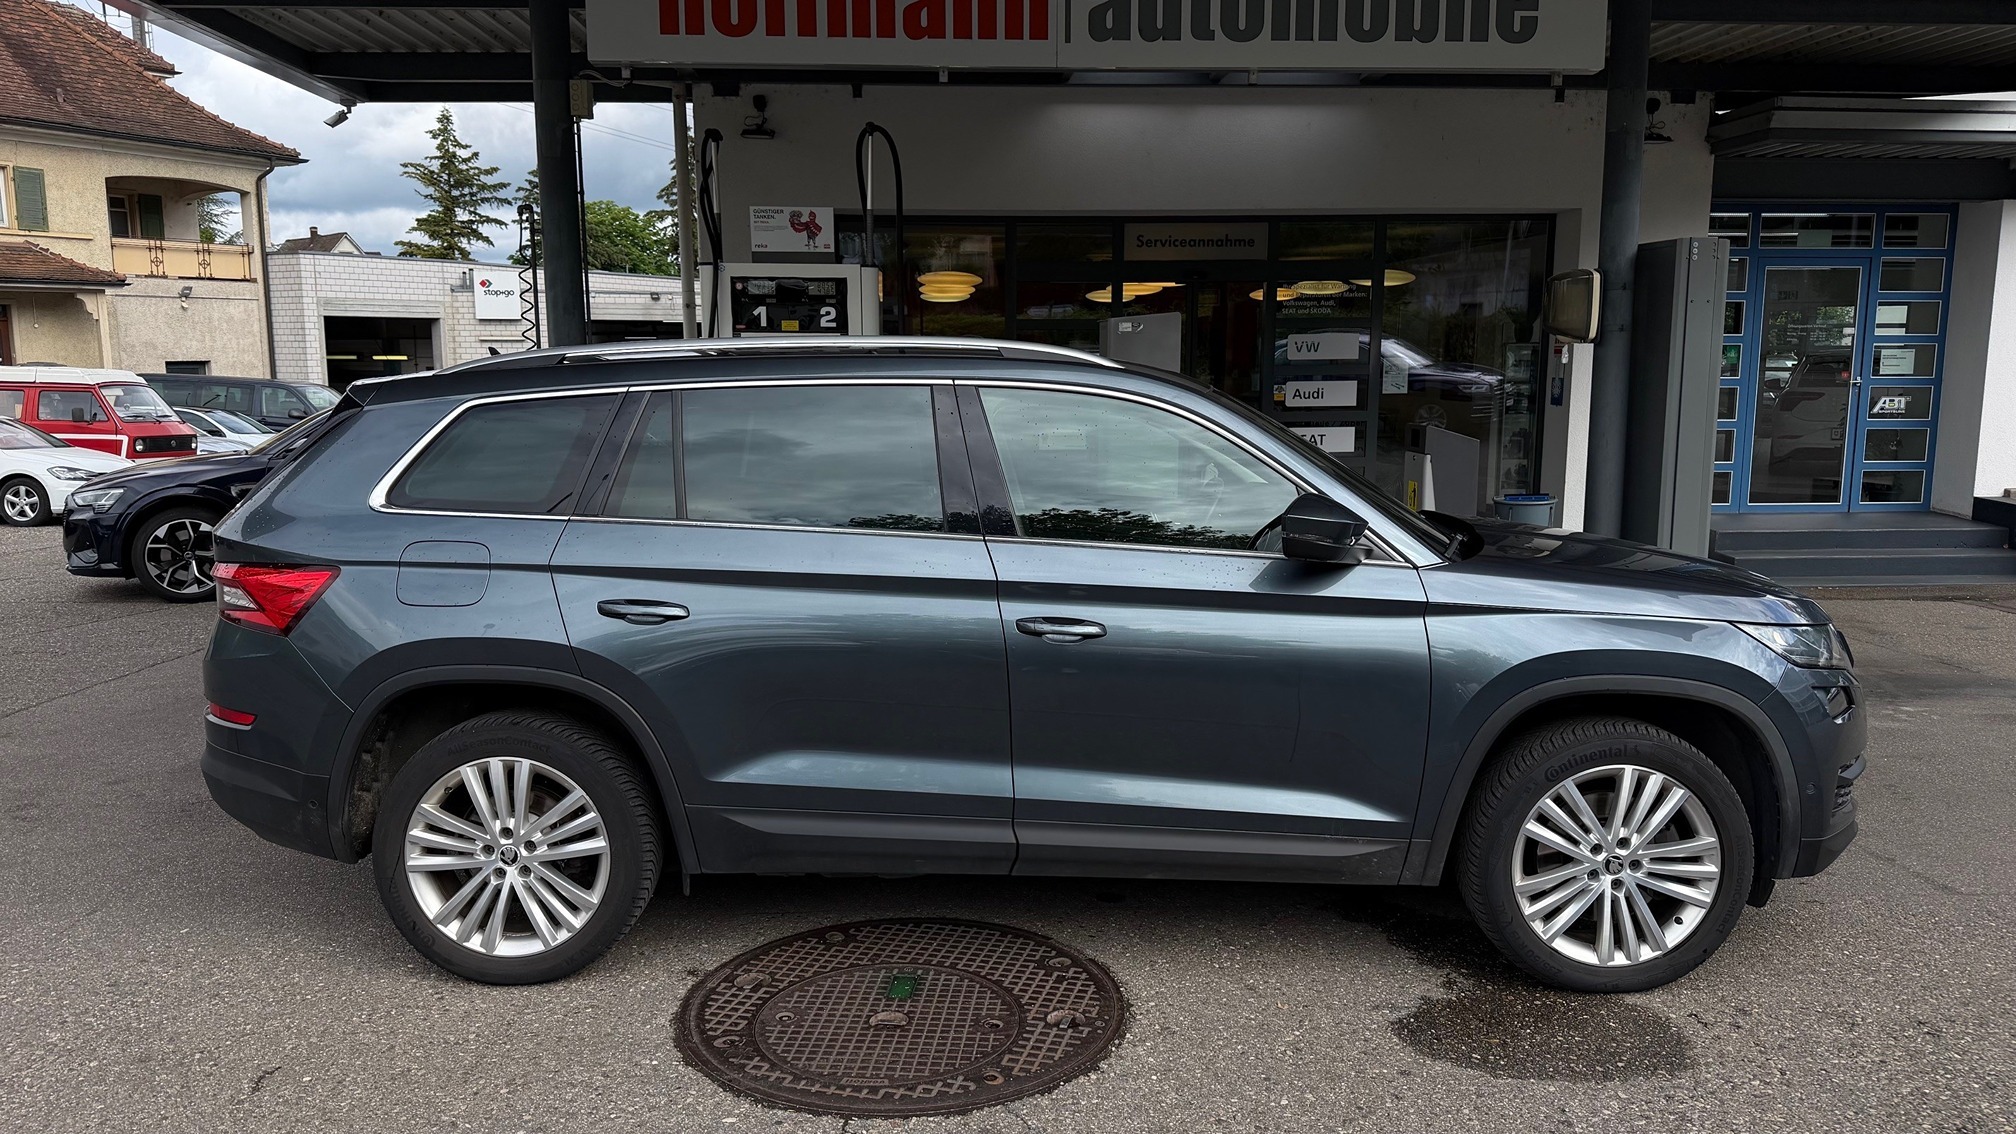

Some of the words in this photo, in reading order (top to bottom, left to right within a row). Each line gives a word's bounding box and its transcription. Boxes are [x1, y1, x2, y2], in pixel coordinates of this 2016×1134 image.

[1136, 234, 1255, 248] Serviceannahme
[752, 306, 767, 327] 1
[820, 307, 837, 327] 2
[1294, 341, 1320, 352] VW
[1292, 388, 1324, 399] Audi
[1870, 396, 1905, 414] ABT
[1300, 434, 1326, 446] AT
[1544, 744, 1627, 782] Continental
